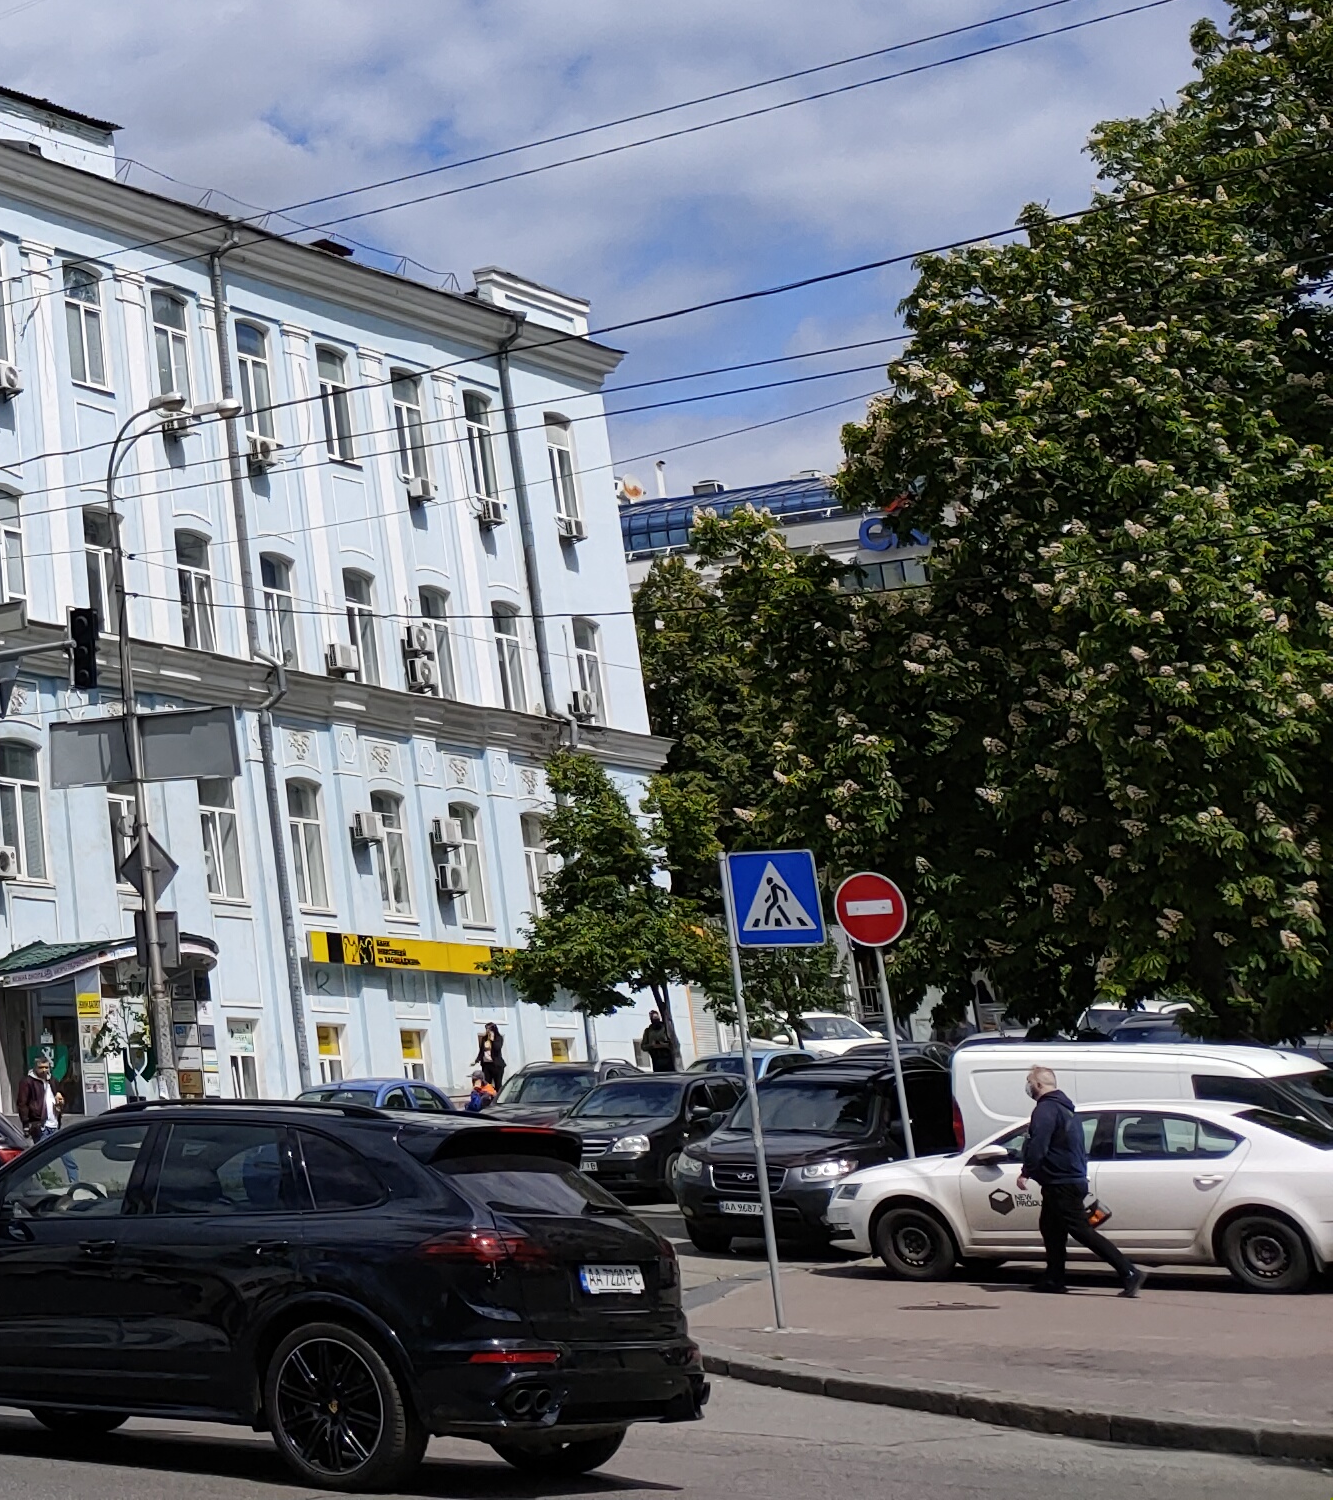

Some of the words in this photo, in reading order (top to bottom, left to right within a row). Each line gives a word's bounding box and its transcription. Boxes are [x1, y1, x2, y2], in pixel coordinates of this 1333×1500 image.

[1015, 1193, 1032, 1201] NEW
[588, 1268, 603, 1286] AA
[625, 1268, 641, 1286] PC
